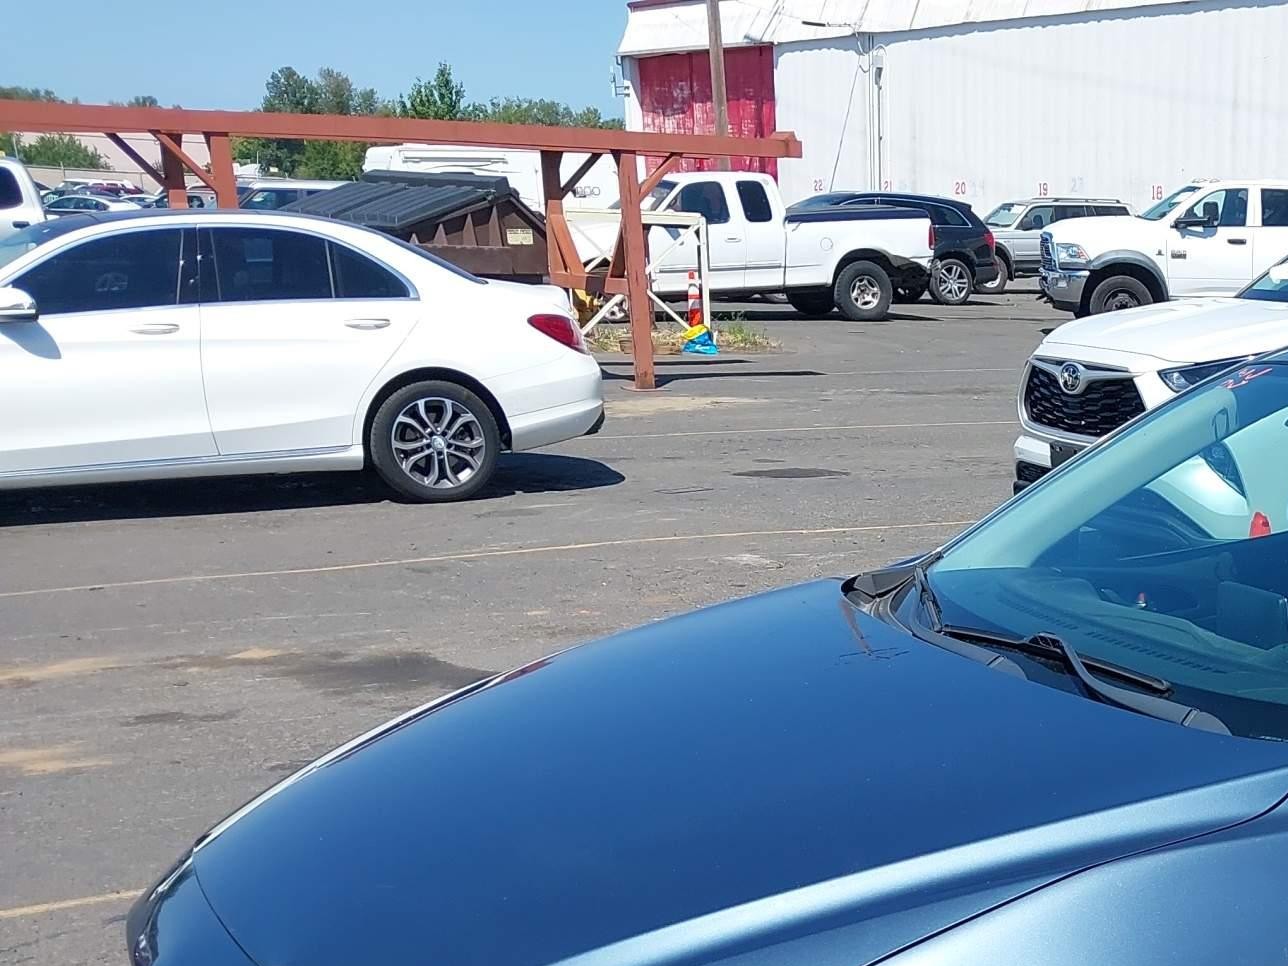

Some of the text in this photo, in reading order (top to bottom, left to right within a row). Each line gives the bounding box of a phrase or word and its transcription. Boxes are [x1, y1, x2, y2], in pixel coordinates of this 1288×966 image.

[813, 180, 823, 191] 22
[955, 182, 966, 195] 20
[1039, 183, 1048, 196] 19
